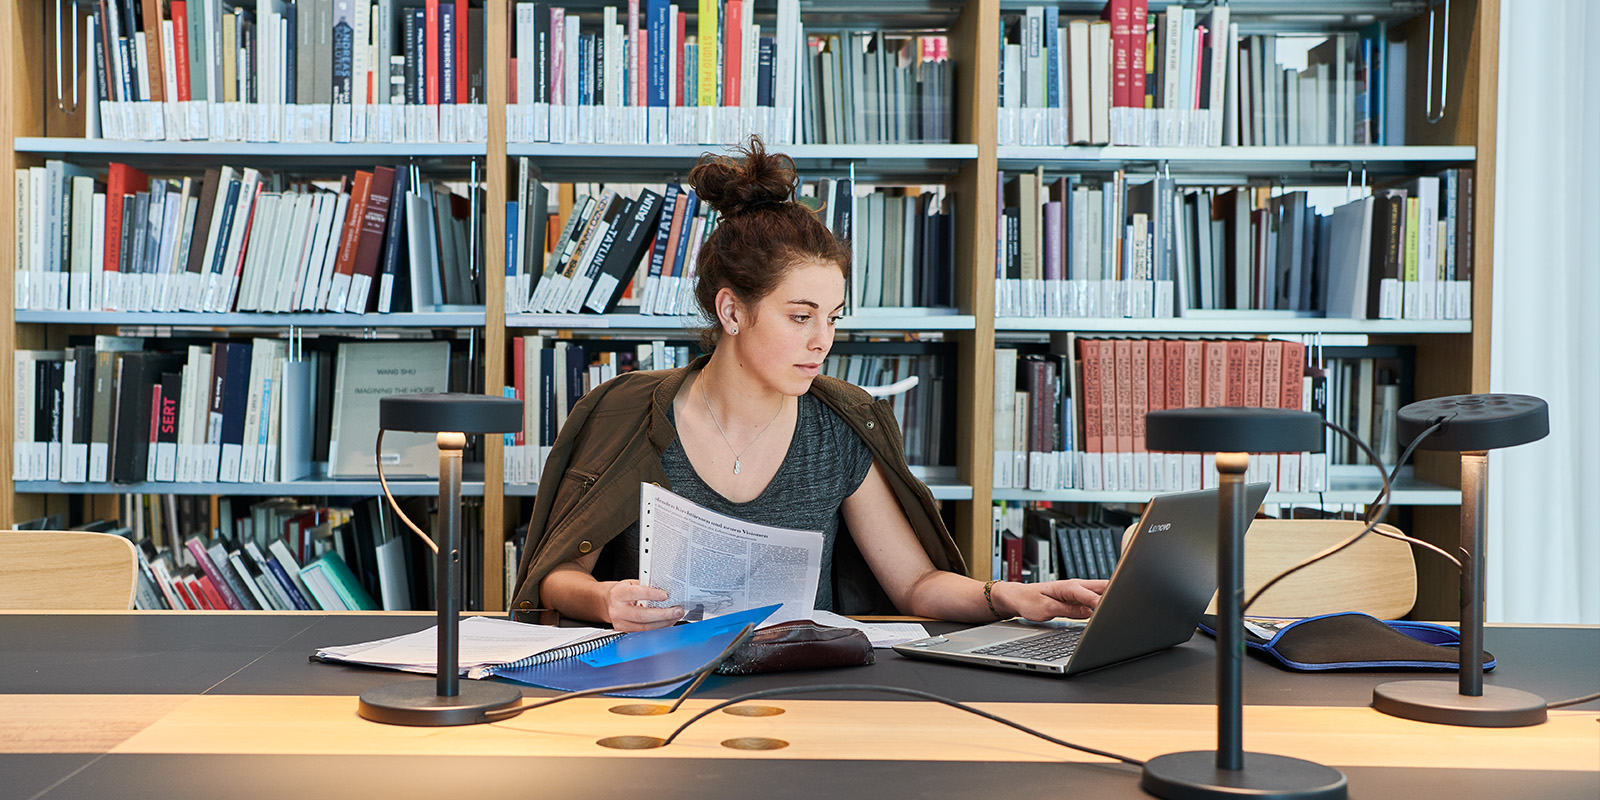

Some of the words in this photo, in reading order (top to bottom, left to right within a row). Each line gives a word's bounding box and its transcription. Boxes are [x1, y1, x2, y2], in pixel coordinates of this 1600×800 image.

[443, 14, 451, 32] KARL
[341, 26, 351, 76] ANDREAS
[443, 32, 451, 68] FRIEDRICH
[702, 35, 712, 68] STUDIO
[443, 69, 451, 101] SCHINKEL
[702, 71, 712, 93] PRIX
[111, 193, 119, 223] RUDOLF
[588, 193, 611, 227] KENZO
[633, 192, 656, 224] TATLIN
[656, 186, 679, 241] TATLIN
[109, 226, 118, 264] SCHWARZ
[573, 224, 595, 258] TANGE
[592, 227, 618, 266] TATLIN
[562, 257, 579, 279] 1946
[17, 361, 25, 392] SEMPER
[17, 393, 25, 439] GOTTFRIED
[52, 388, 61, 414] Semper
[161, 396, 176, 434] SERT
[711, 520, 723, 529] und
[723, 525, 742, 534] neuen
[742, 528, 769, 539] Visionen
[1148, 523, 1171, 534] Lenovo
